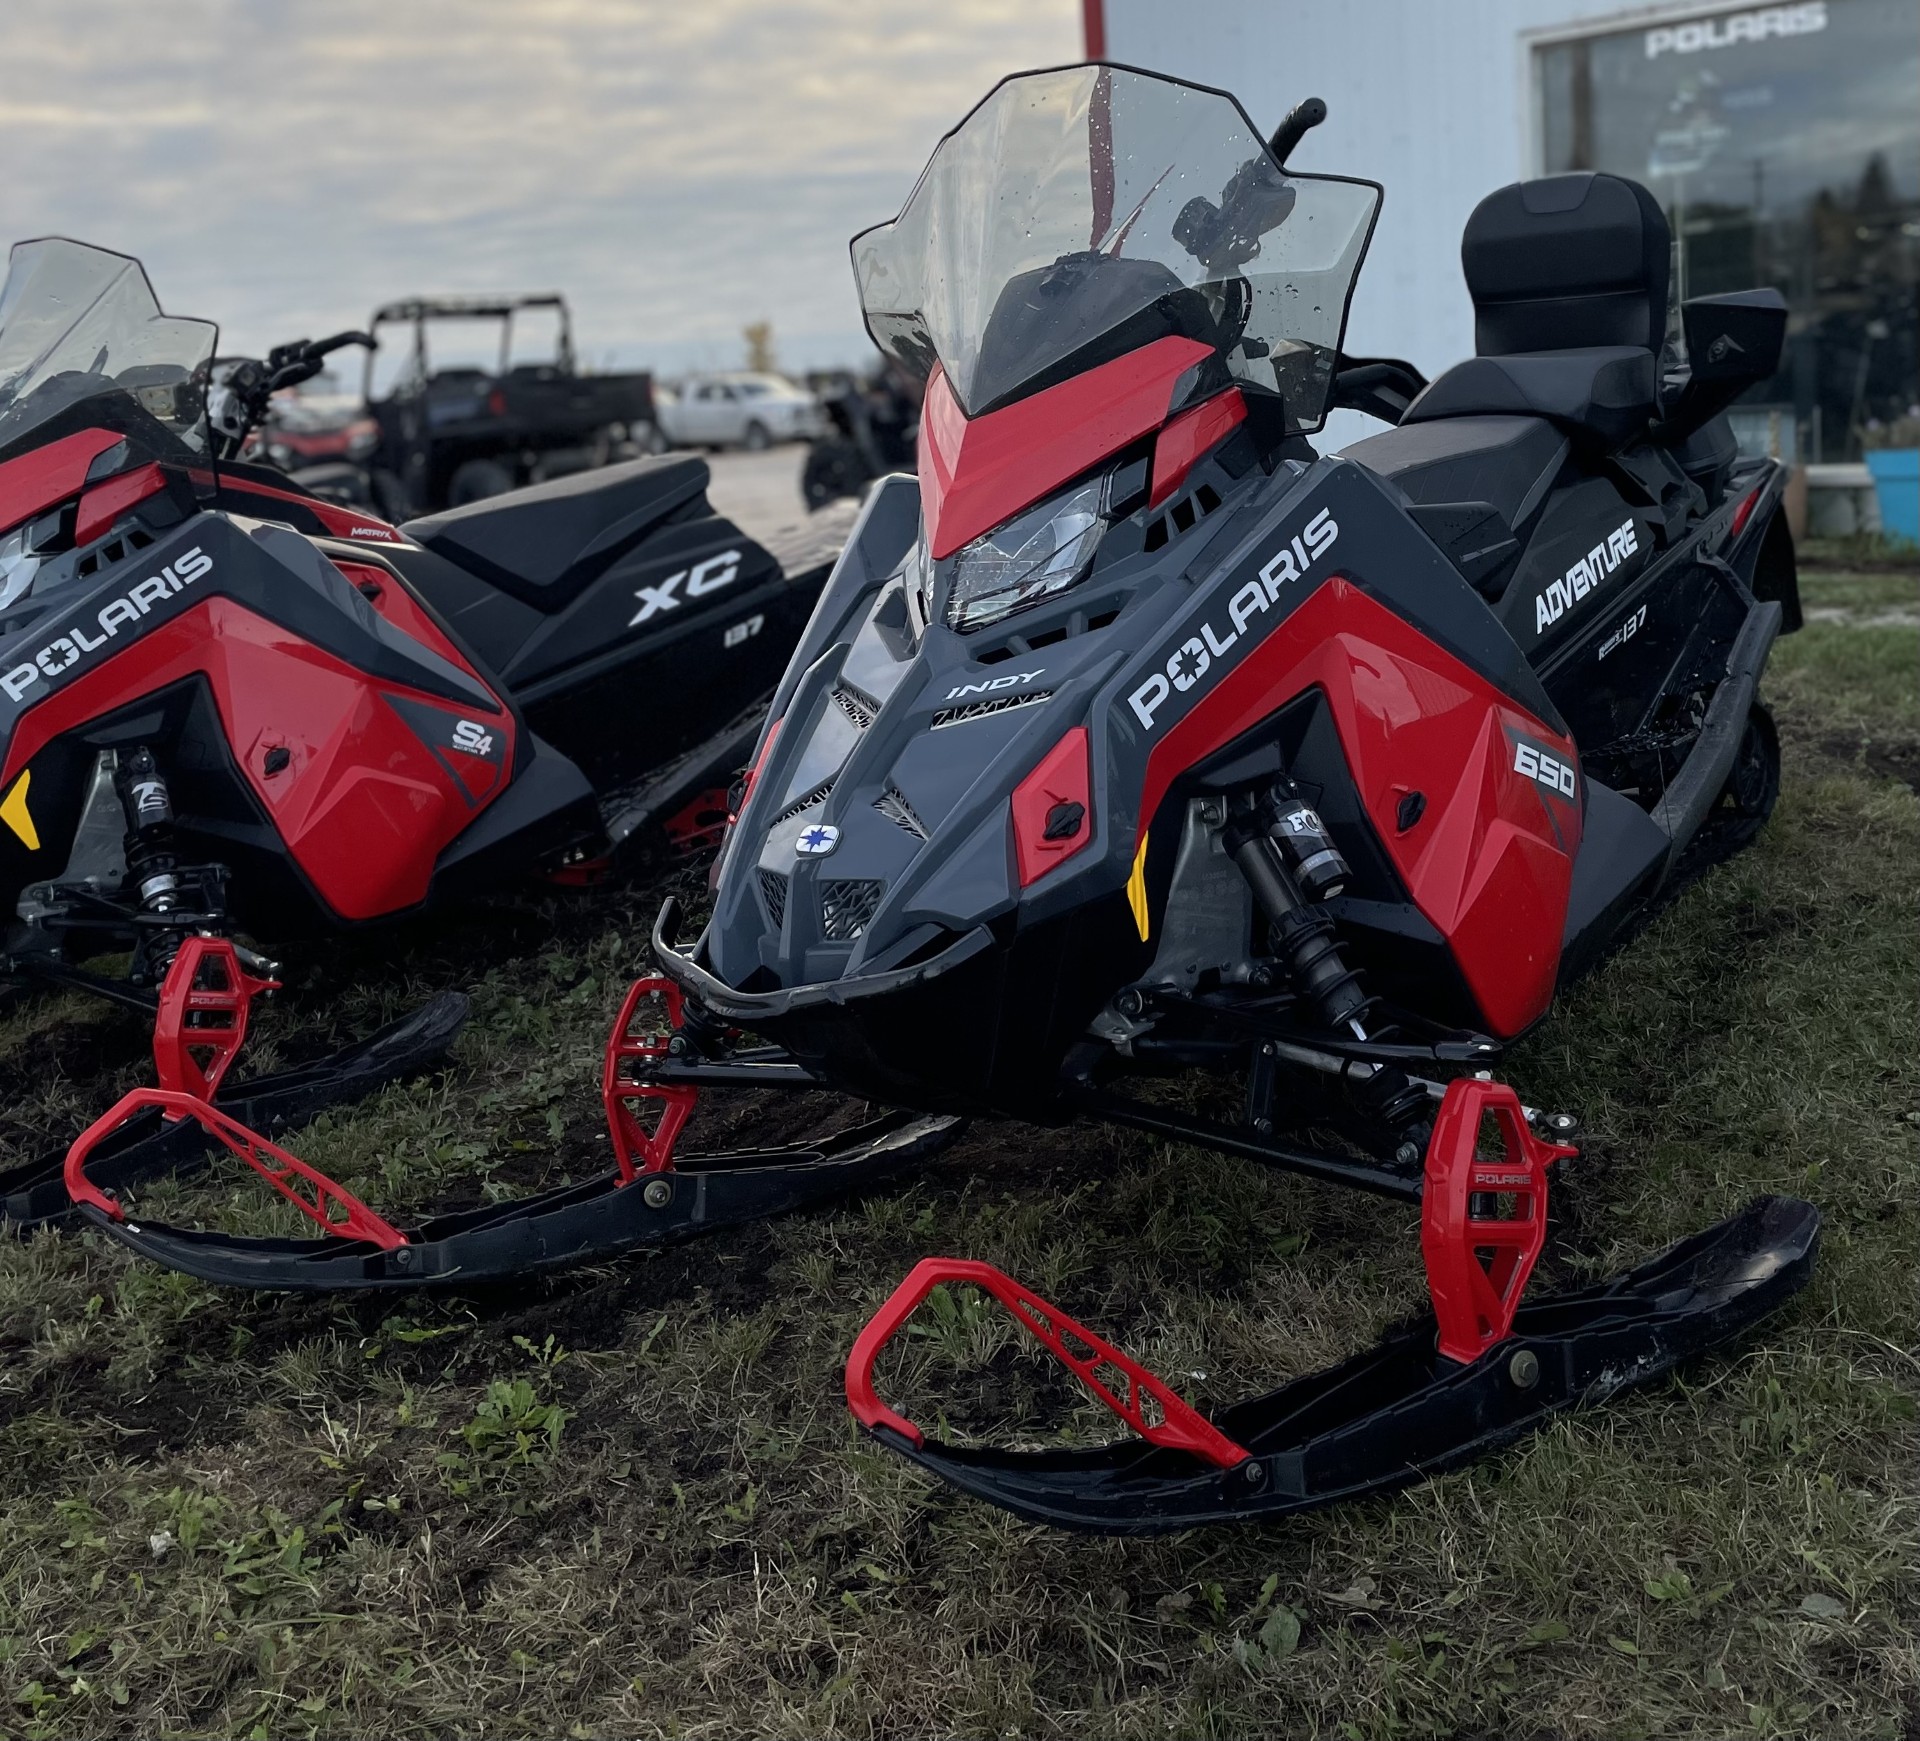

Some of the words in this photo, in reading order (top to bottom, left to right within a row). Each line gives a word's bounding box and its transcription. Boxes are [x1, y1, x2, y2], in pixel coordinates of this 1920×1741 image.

[1645, 2, 1828, 59] POLARIS
[350, 526, 393, 541] MATRYX
[628, 550, 742, 627] XC
[1535, 518, 1639, 635] ADVENTURE
[0, 546, 213, 703] POLARIS
[1127, 507, 1339, 731] POLARIS
[1622, 604, 1647, 643] 137
[945, 668, 1046, 700] INDY
[1513, 742, 1576, 799] 650
[1474, 1174, 1532, 1185] POLARIS
